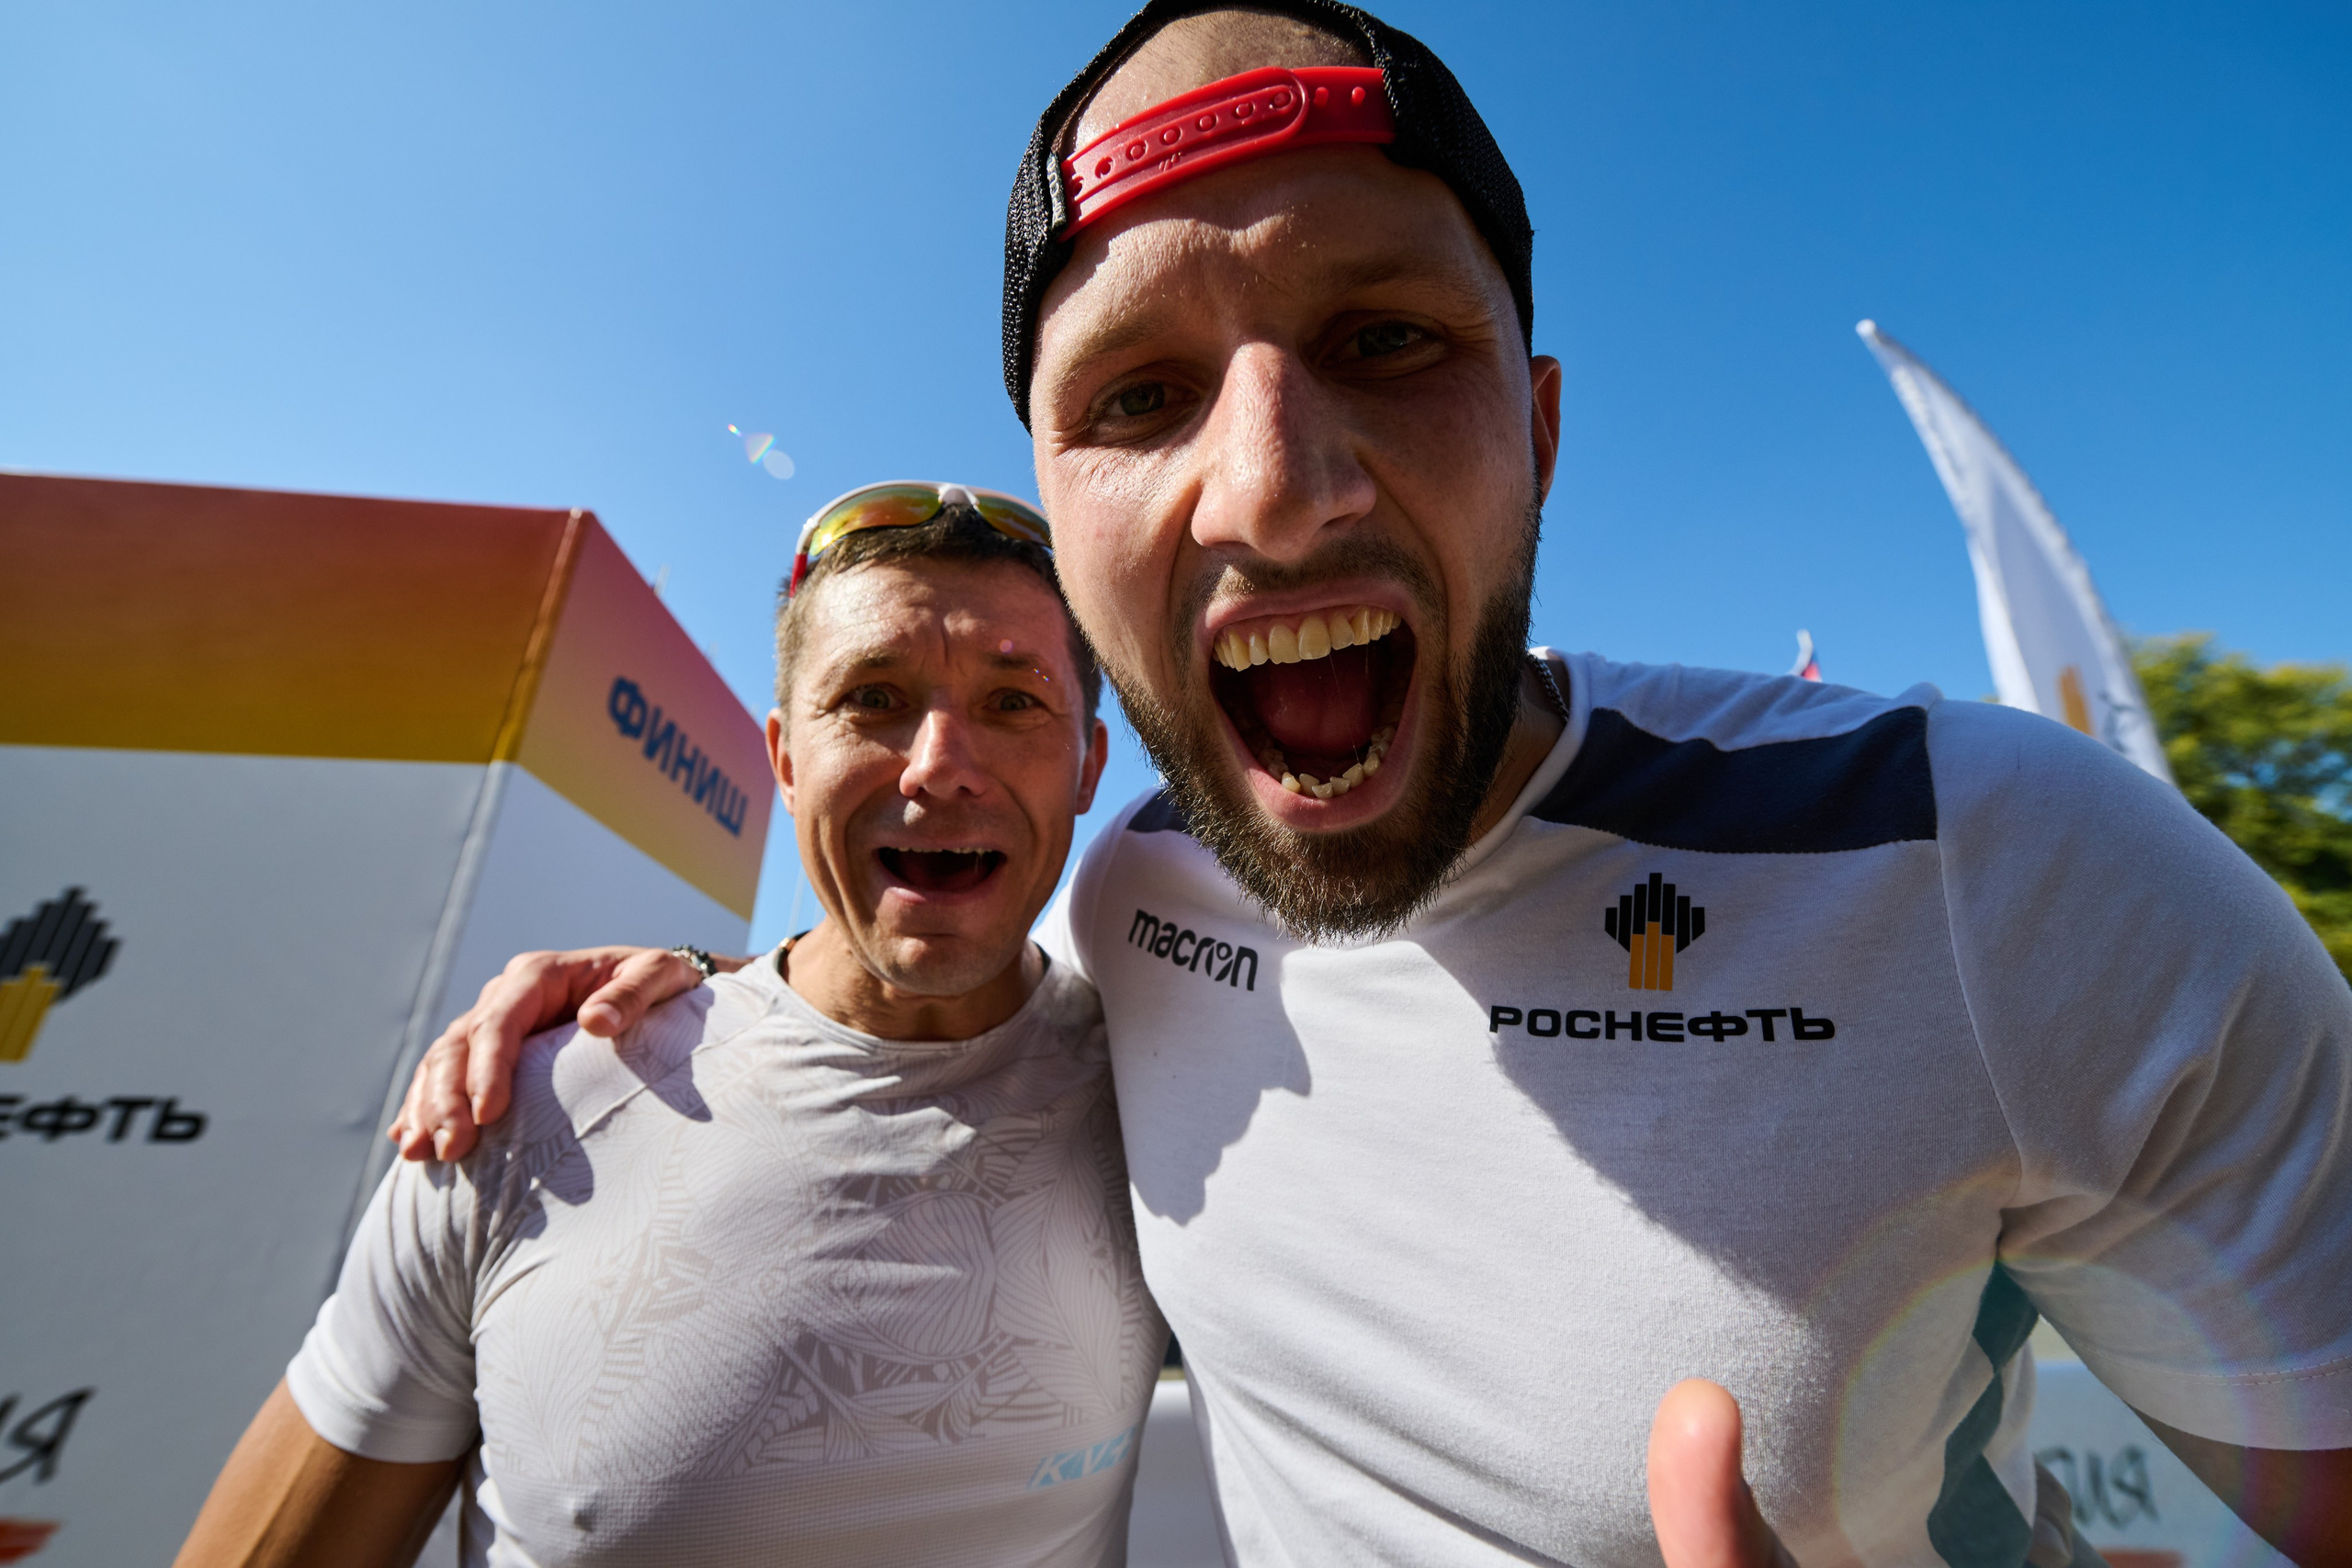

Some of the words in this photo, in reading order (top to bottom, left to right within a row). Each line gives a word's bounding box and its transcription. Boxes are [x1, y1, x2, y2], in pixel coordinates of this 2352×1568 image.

[608, 675, 749, 840] ФИНИШ
[1127, 908, 1259, 992] macron
[1488, 1005, 1836, 1043] РОСНЕФТЬ
